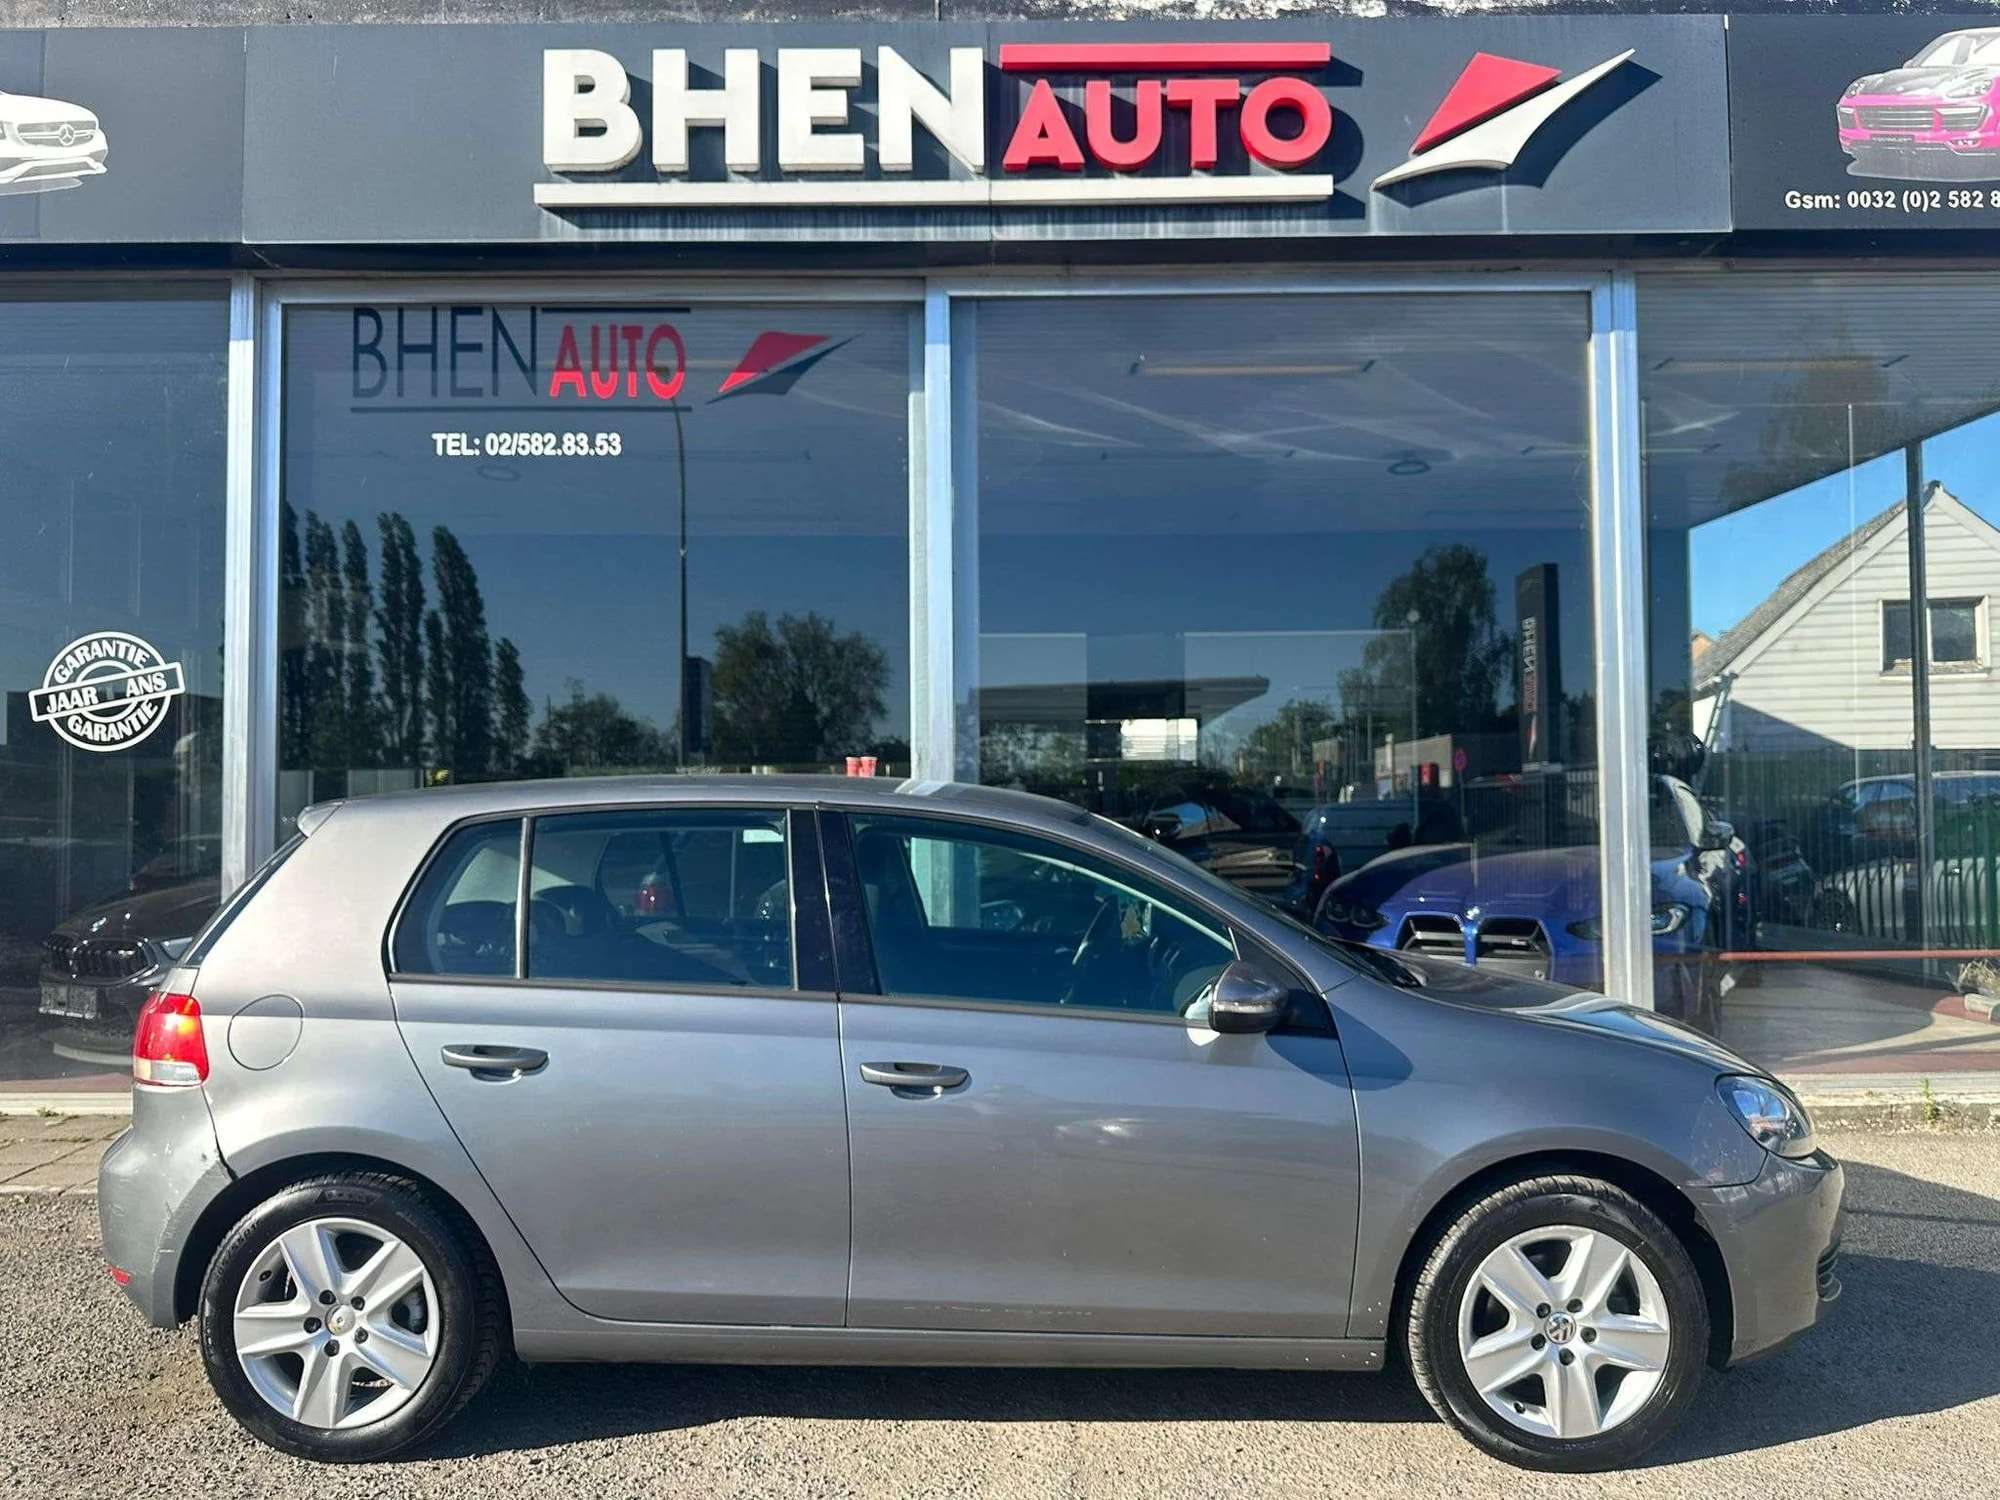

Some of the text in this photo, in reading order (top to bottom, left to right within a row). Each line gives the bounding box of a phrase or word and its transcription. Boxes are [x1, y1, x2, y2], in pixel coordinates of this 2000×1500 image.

[543, 45, 1333, 174] BHEN AUTO
[1784, 190, 1841, 209] Gsm:
[1847, 190, 1896, 209] 0032
[1902, 190, 1941, 213] (0)2
[1947, 190, 1984, 209] 582
[352, 305, 687, 400] BHEN AUTO
[432, 432, 623, 457] TEL: 02/582.83.53
[54, 639, 150, 683] GARANTIE
[46, 672, 167, 714] JAAR ANS
[67, 701, 158, 742] GARANTIE
